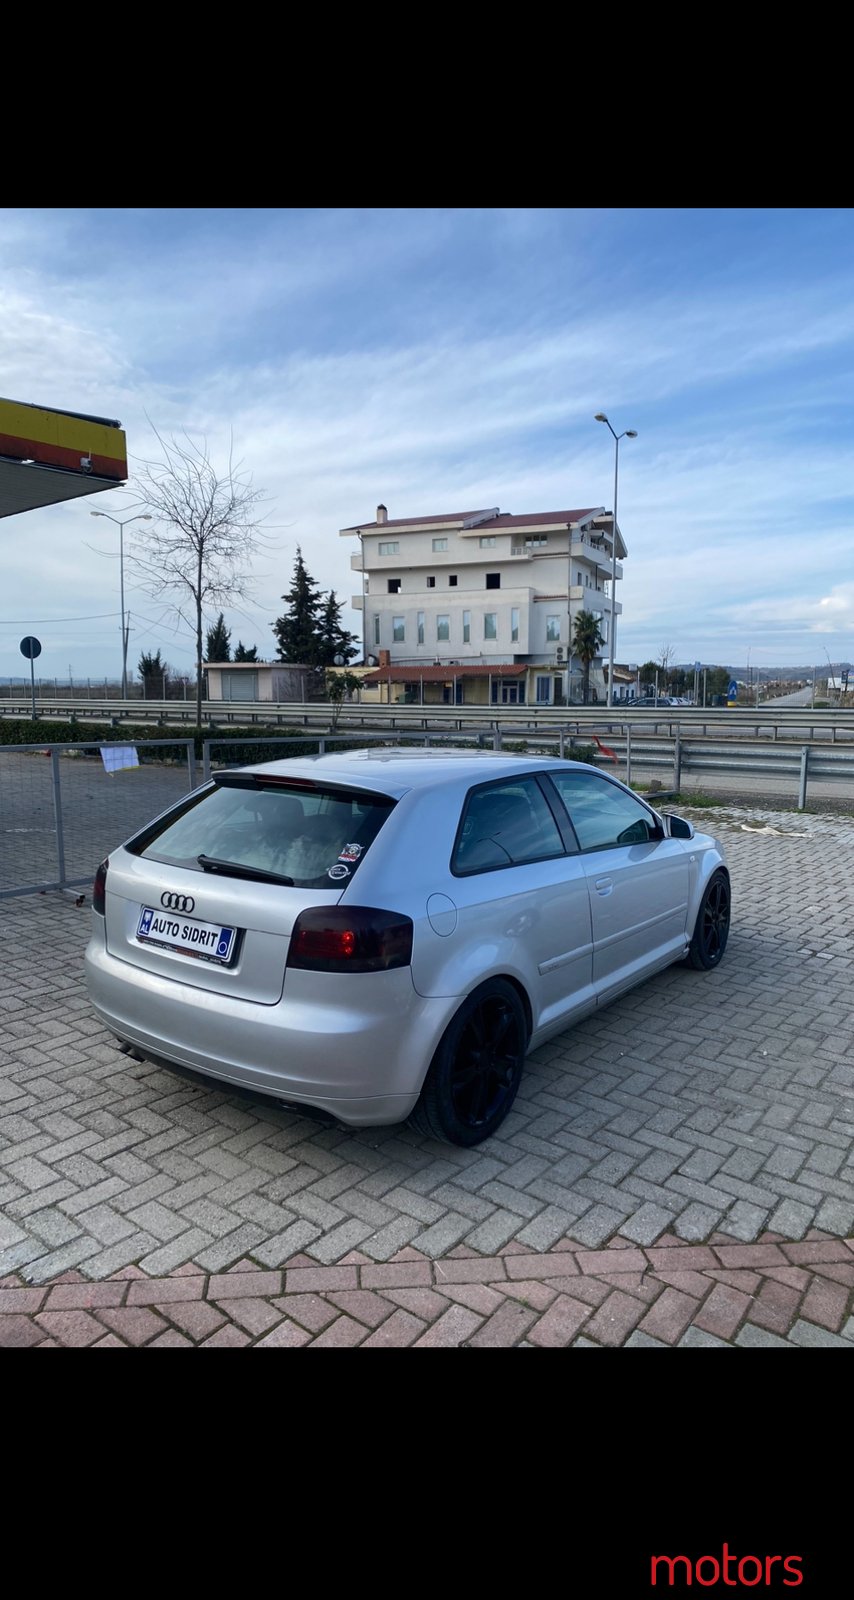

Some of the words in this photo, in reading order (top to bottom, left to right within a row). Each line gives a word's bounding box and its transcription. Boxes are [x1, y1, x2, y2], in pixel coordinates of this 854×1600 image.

[140, 924, 148, 933] AL
[151, 918, 180, 937] AUTO
[181, 925, 218, 947] SIDRIT
